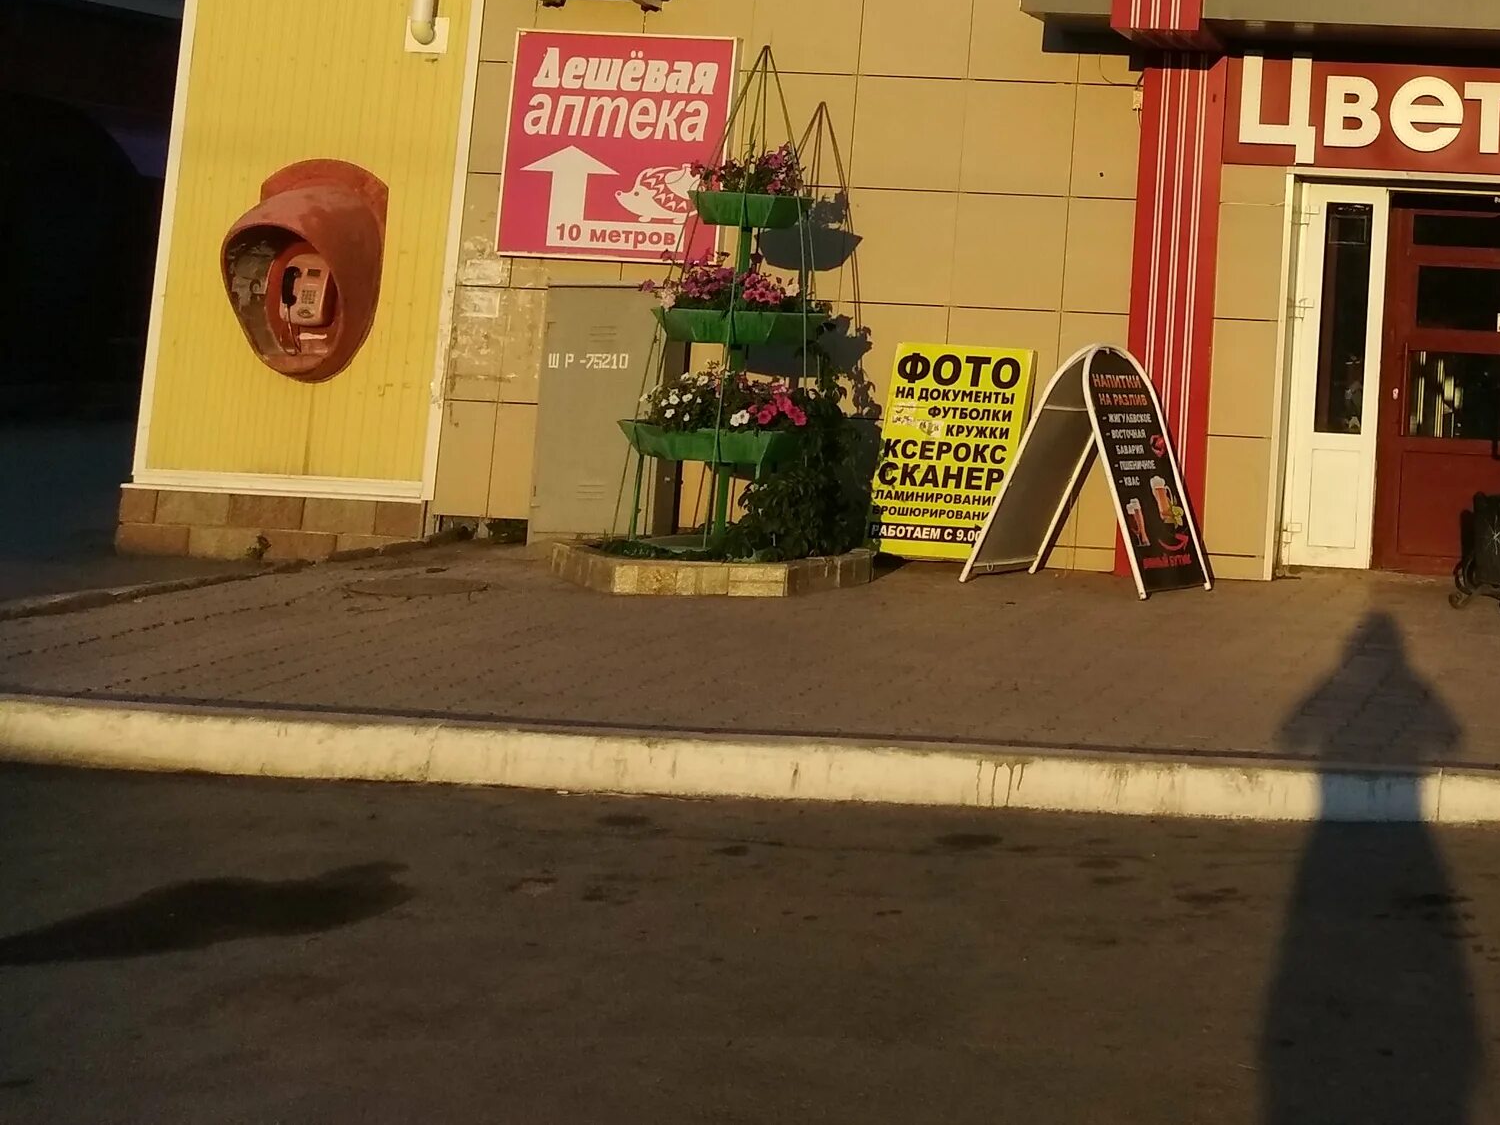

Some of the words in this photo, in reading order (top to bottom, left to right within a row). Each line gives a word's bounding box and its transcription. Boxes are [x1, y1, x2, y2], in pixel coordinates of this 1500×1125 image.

[532, 47, 719, 95] Дешёвая
[523, 93, 709, 142] аптека
[556, 223, 582, 241] 10
[589, 228, 676, 248] метров
[897, 353, 1021, 389] ФОТО
[1092, 374, 1142, 388] НАПИТКИ
[895, 386, 915, 399] НА
[917, 387, 1015, 405] ДОКУМЕНТЫ
[1098, 393, 1112, 405] НА
[1112, 393, 1148, 406] РАЗЛИВ
[928, 405, 1012, 422] ФУТБОЛКИ
[945, 424, 1010, 440] КРУЖКИ
[883, 438, 1007, 465] КСЕРОКС
[1115, 444, 1145, 455] БАВАРИЯ
[878, 462, 1004, 491] СКАНЕР
[1123, 476, 1141, 486] КВАС
[871, 524, 941, 539] РАБОТАЕМ
[944, 528, 953, 541] С
